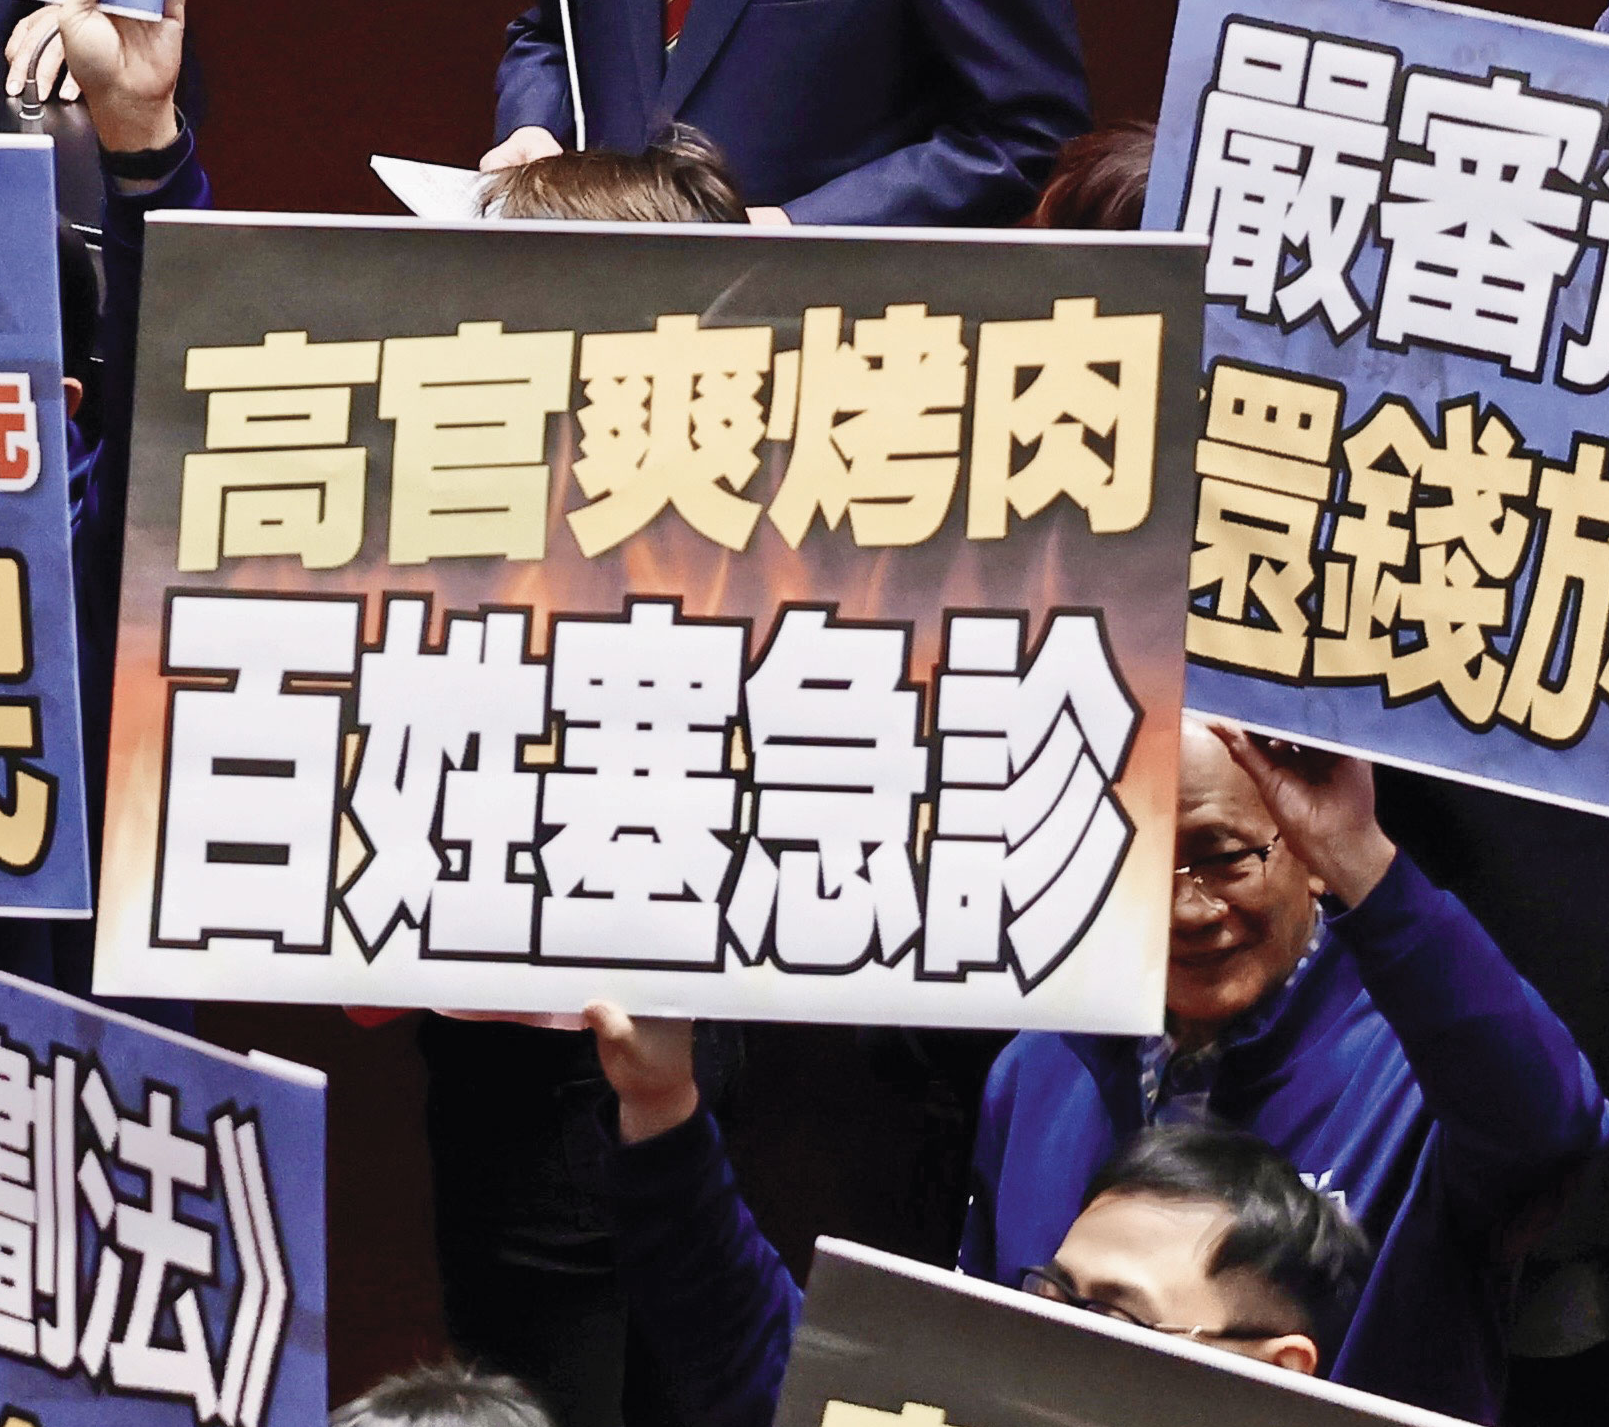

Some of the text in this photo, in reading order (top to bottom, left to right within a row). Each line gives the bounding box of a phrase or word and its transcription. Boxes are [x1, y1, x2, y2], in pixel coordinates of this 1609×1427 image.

[176, 297, 1165, 573] 高官爽烤肉
[149, 588, 1143, 995] 百姓塞急診
